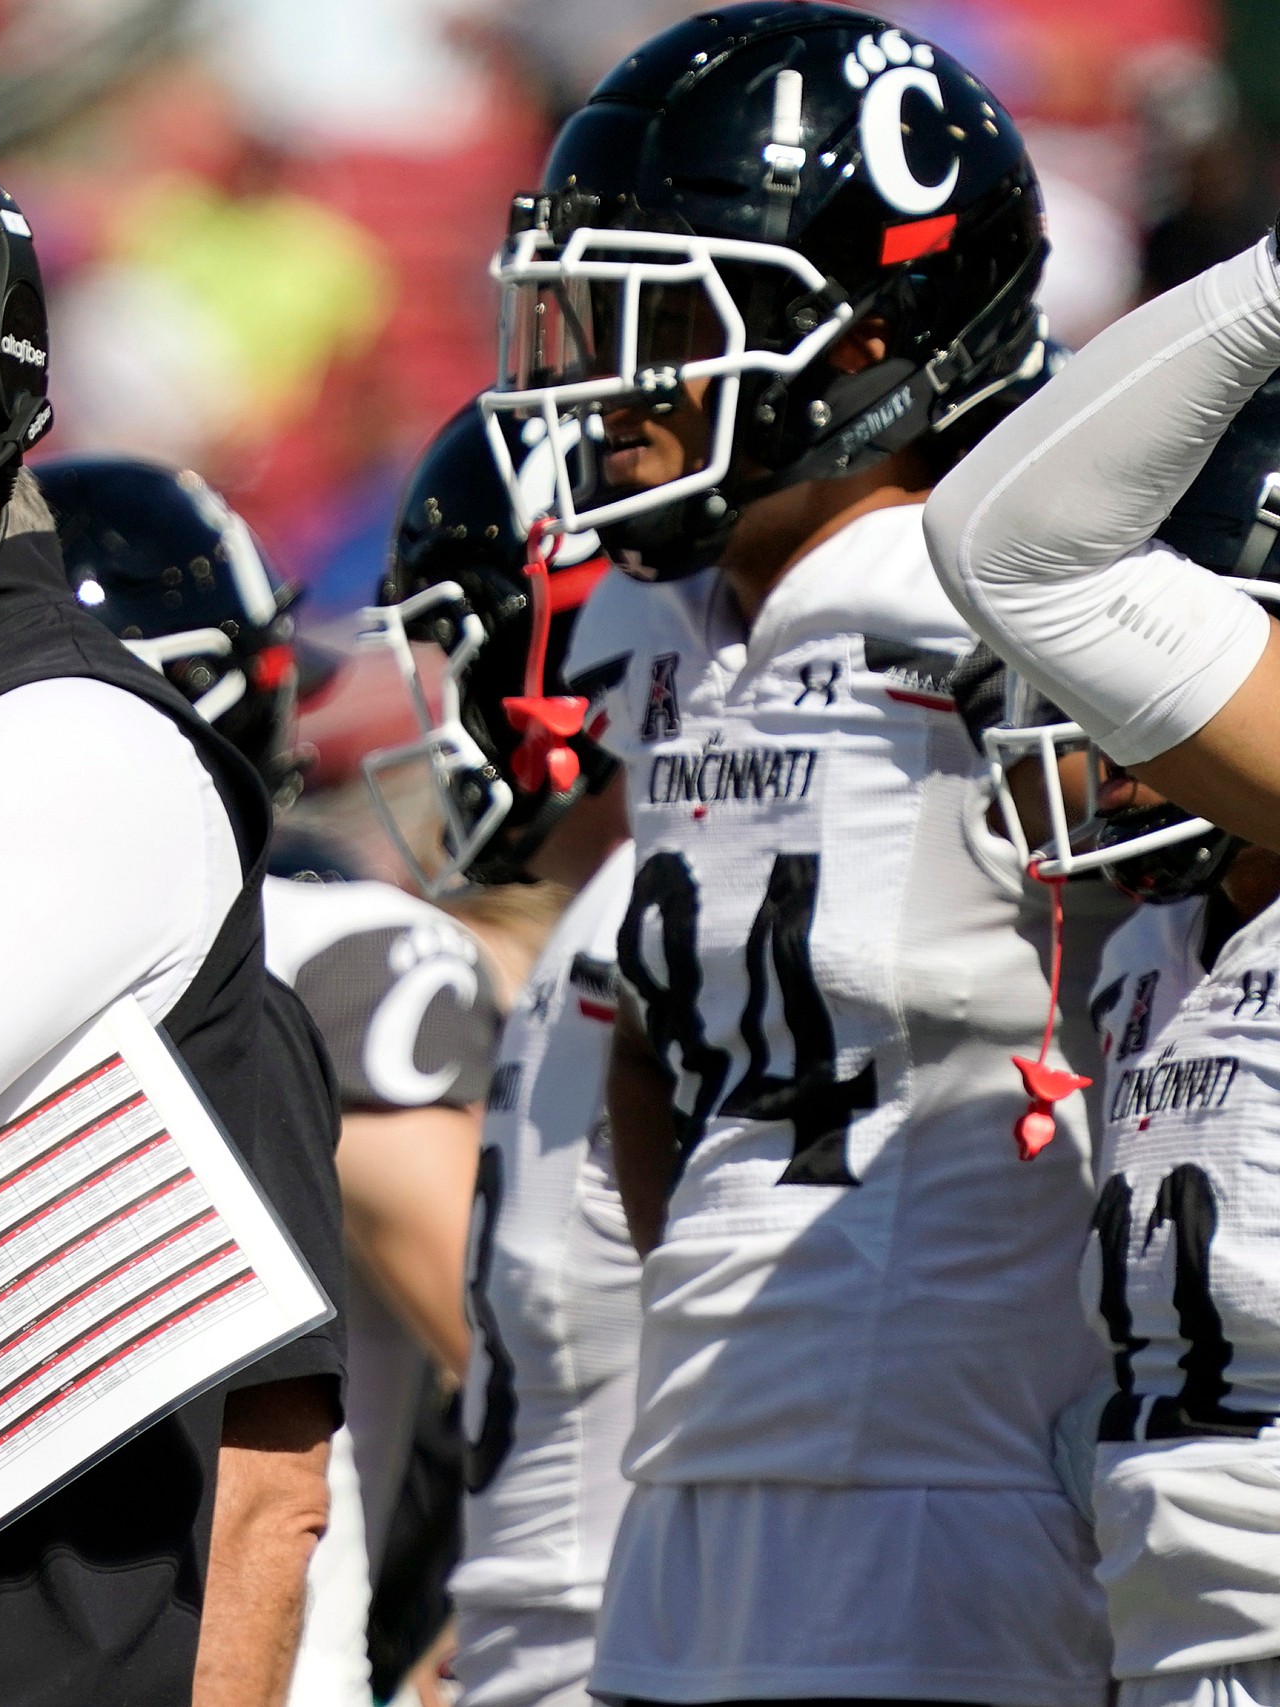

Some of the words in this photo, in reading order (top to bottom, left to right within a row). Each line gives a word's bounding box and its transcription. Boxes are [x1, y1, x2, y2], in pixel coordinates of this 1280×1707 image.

[859, 64, 960, 215] C
[1, 332, 47, 366] altafiber
[649, 749, 818, 804] CINCINNATI
[1109, 1056, 1240, 1124] CINCINNATI
